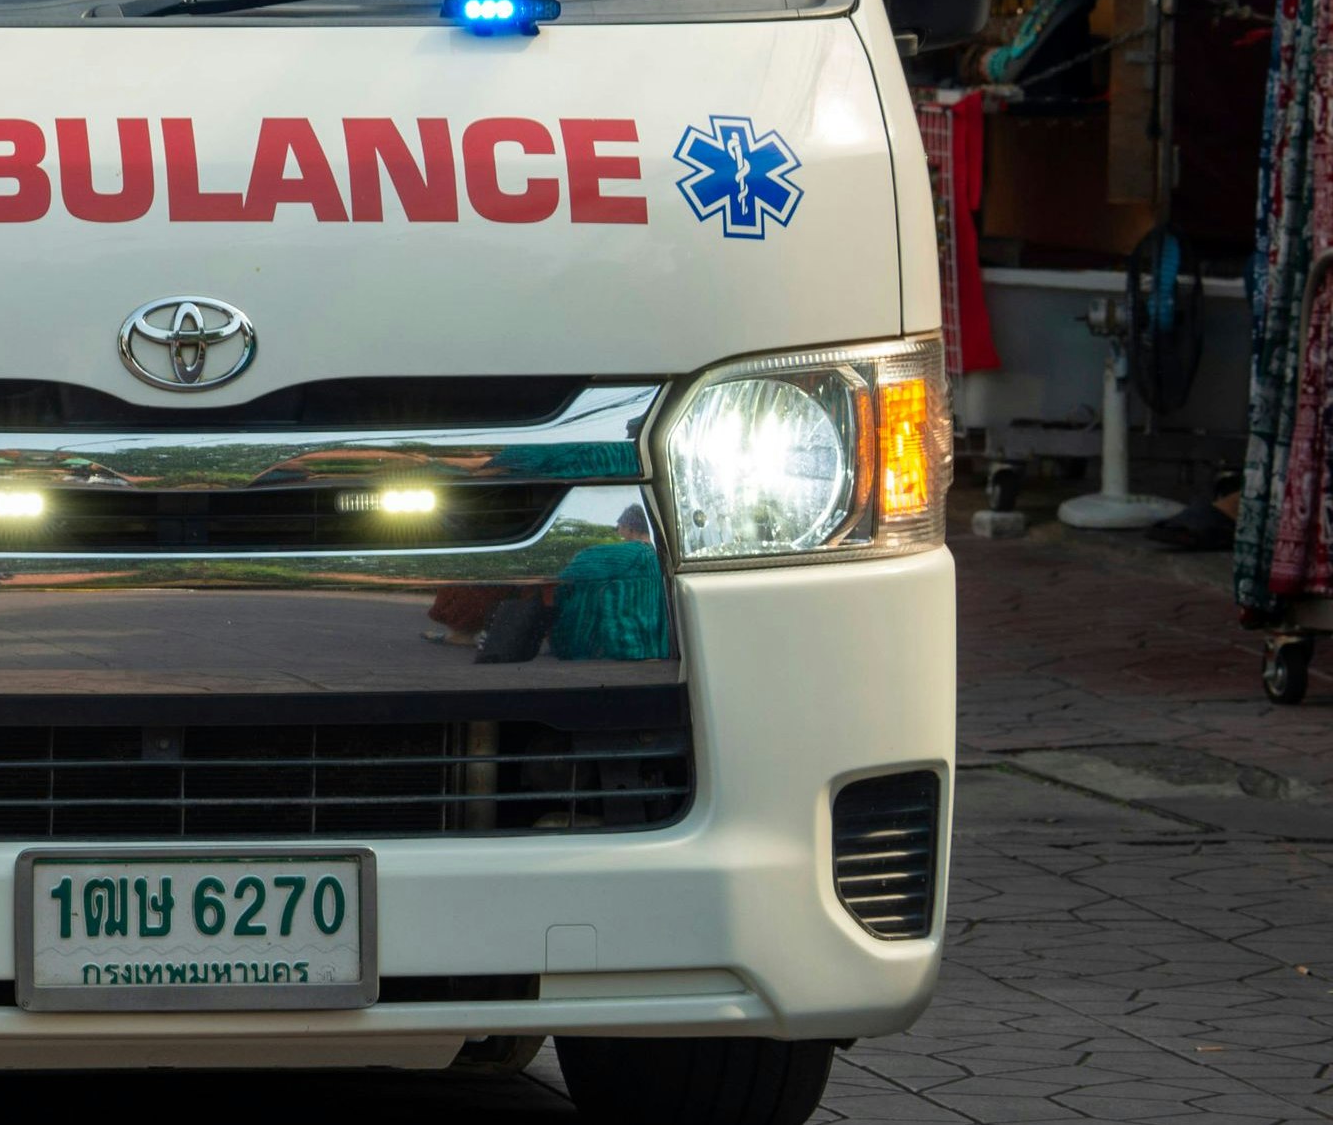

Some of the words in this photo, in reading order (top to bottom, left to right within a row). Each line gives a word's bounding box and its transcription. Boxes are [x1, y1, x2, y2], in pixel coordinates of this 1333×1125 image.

[193, 875, 346, 936] 6270
[81, 961, 310, 984] กรงเทพมหานคร
